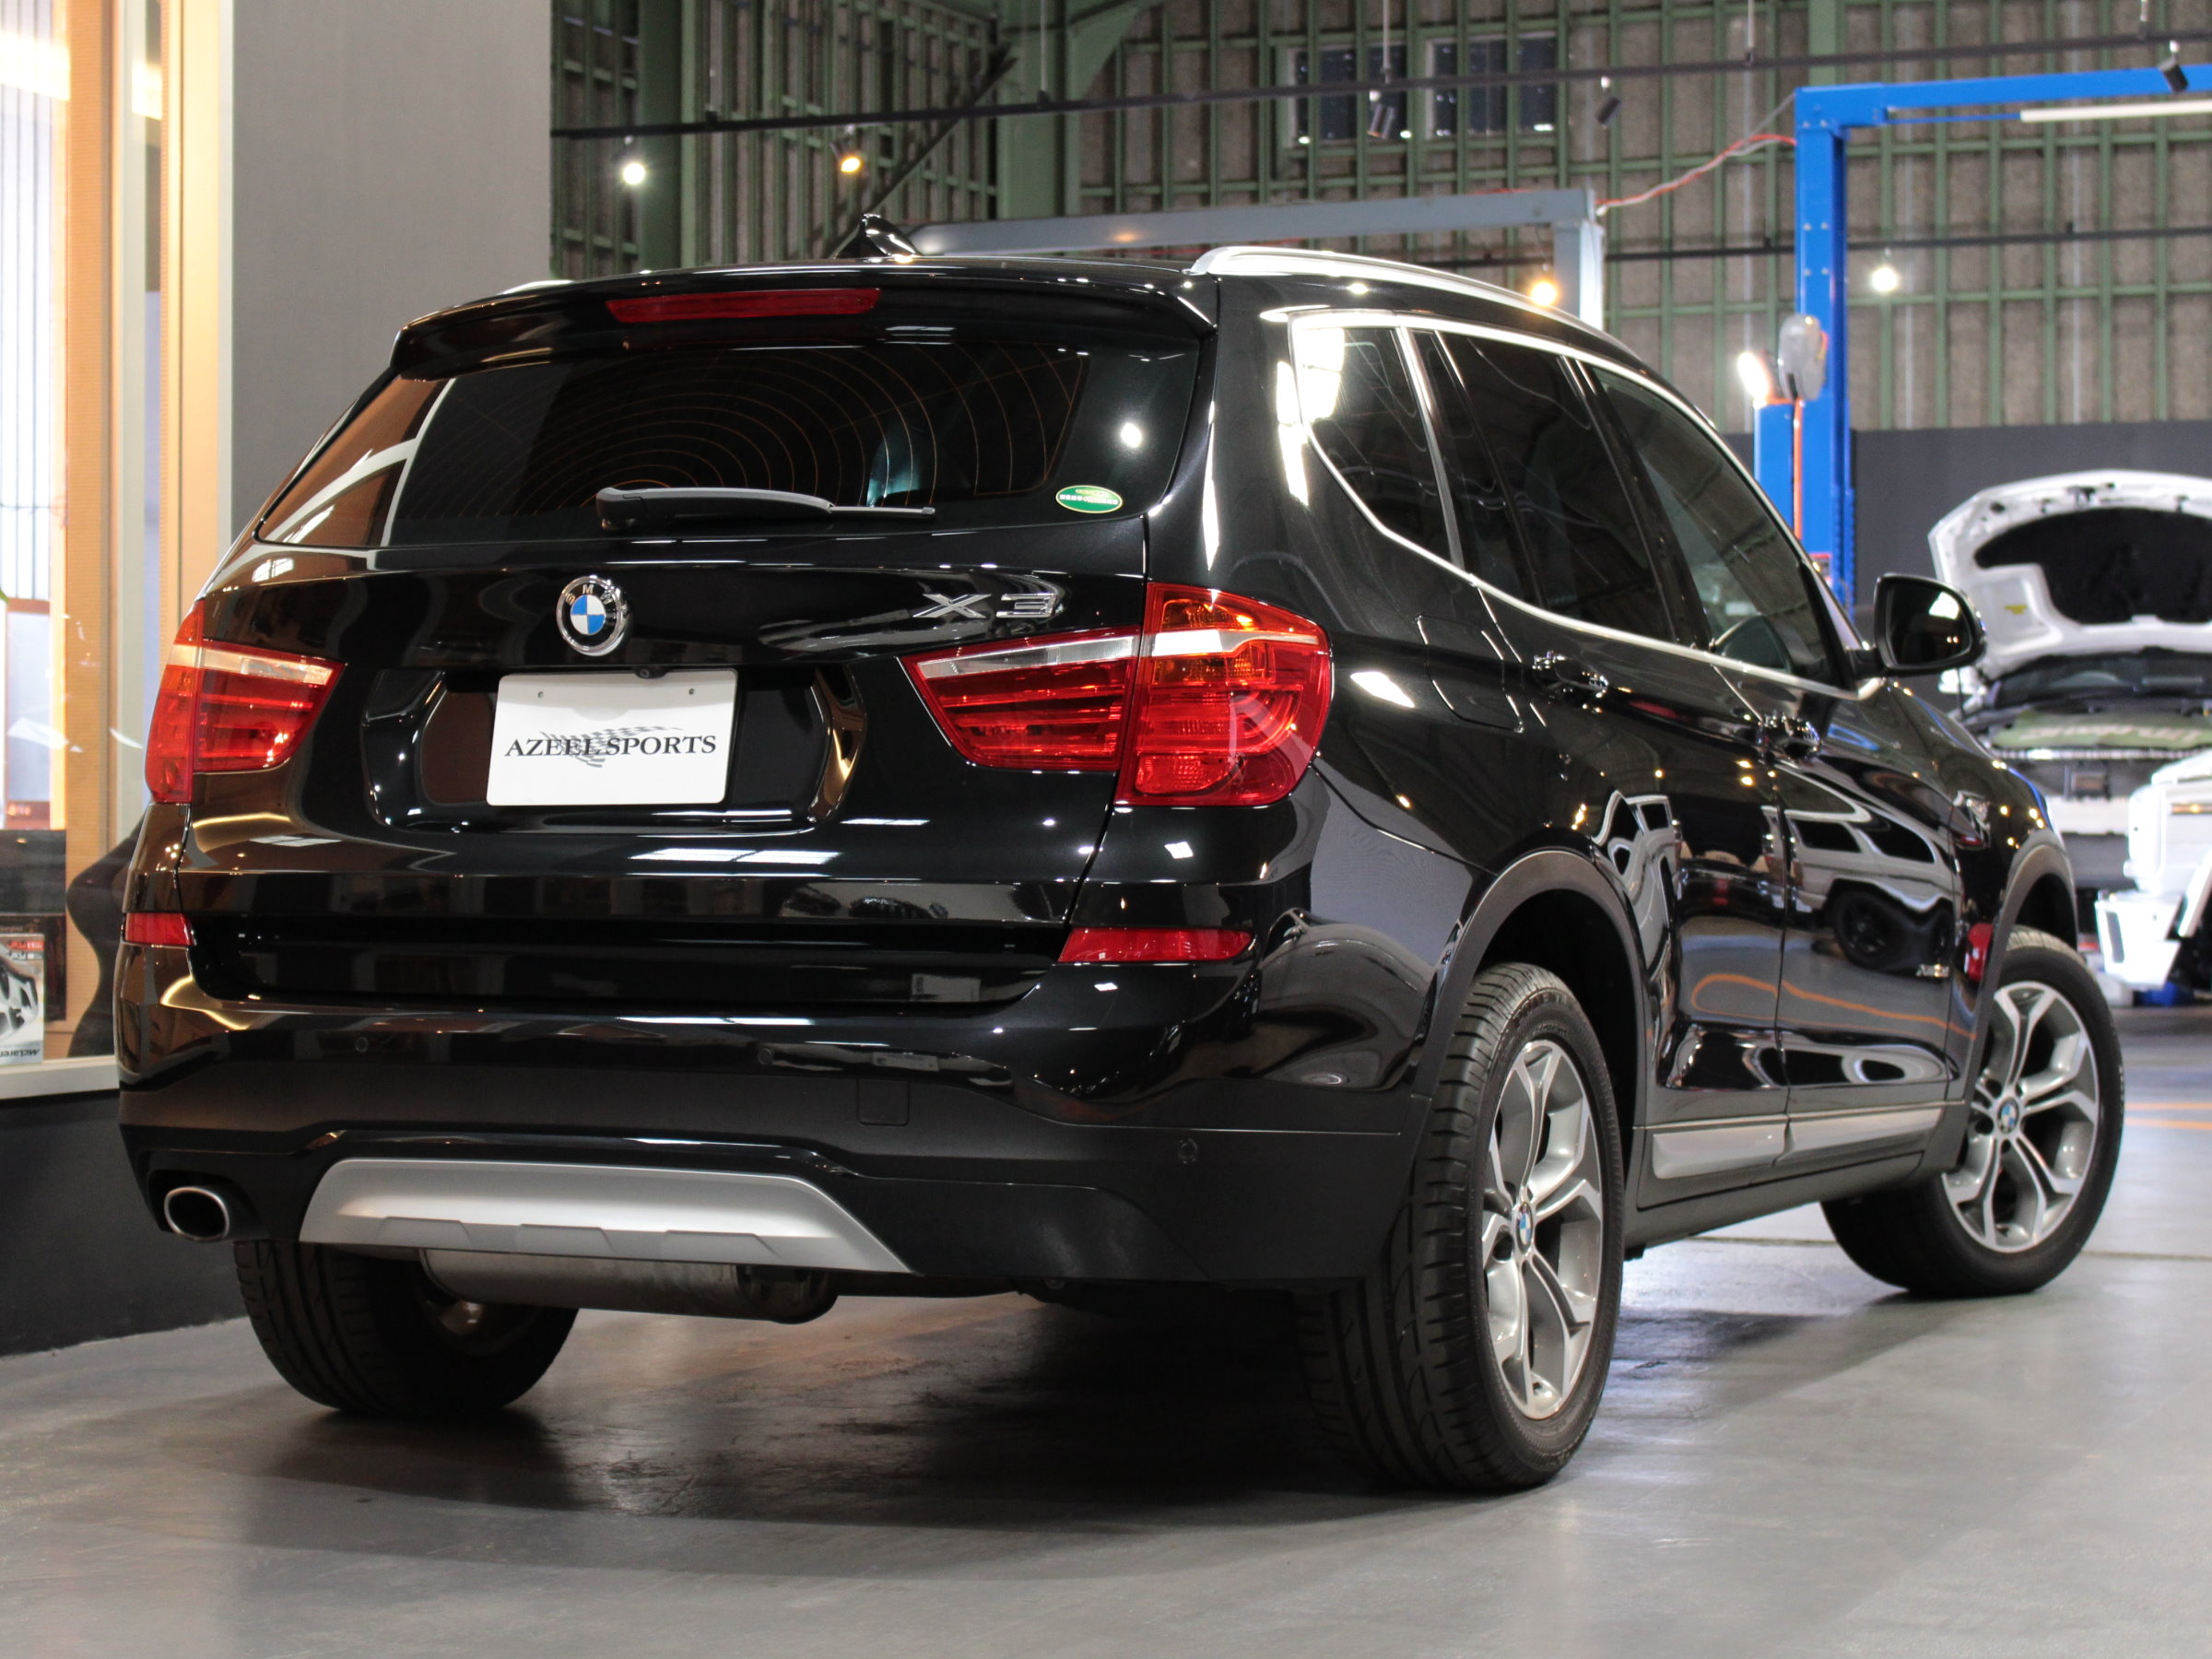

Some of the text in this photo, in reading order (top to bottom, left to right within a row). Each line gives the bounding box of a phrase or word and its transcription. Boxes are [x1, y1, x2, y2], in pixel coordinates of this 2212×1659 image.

[565, 583, 614, 606] BMW
[912, 593, 1057, 618] X3
[504, 735, 716, 757] AZEEL SPORTS
